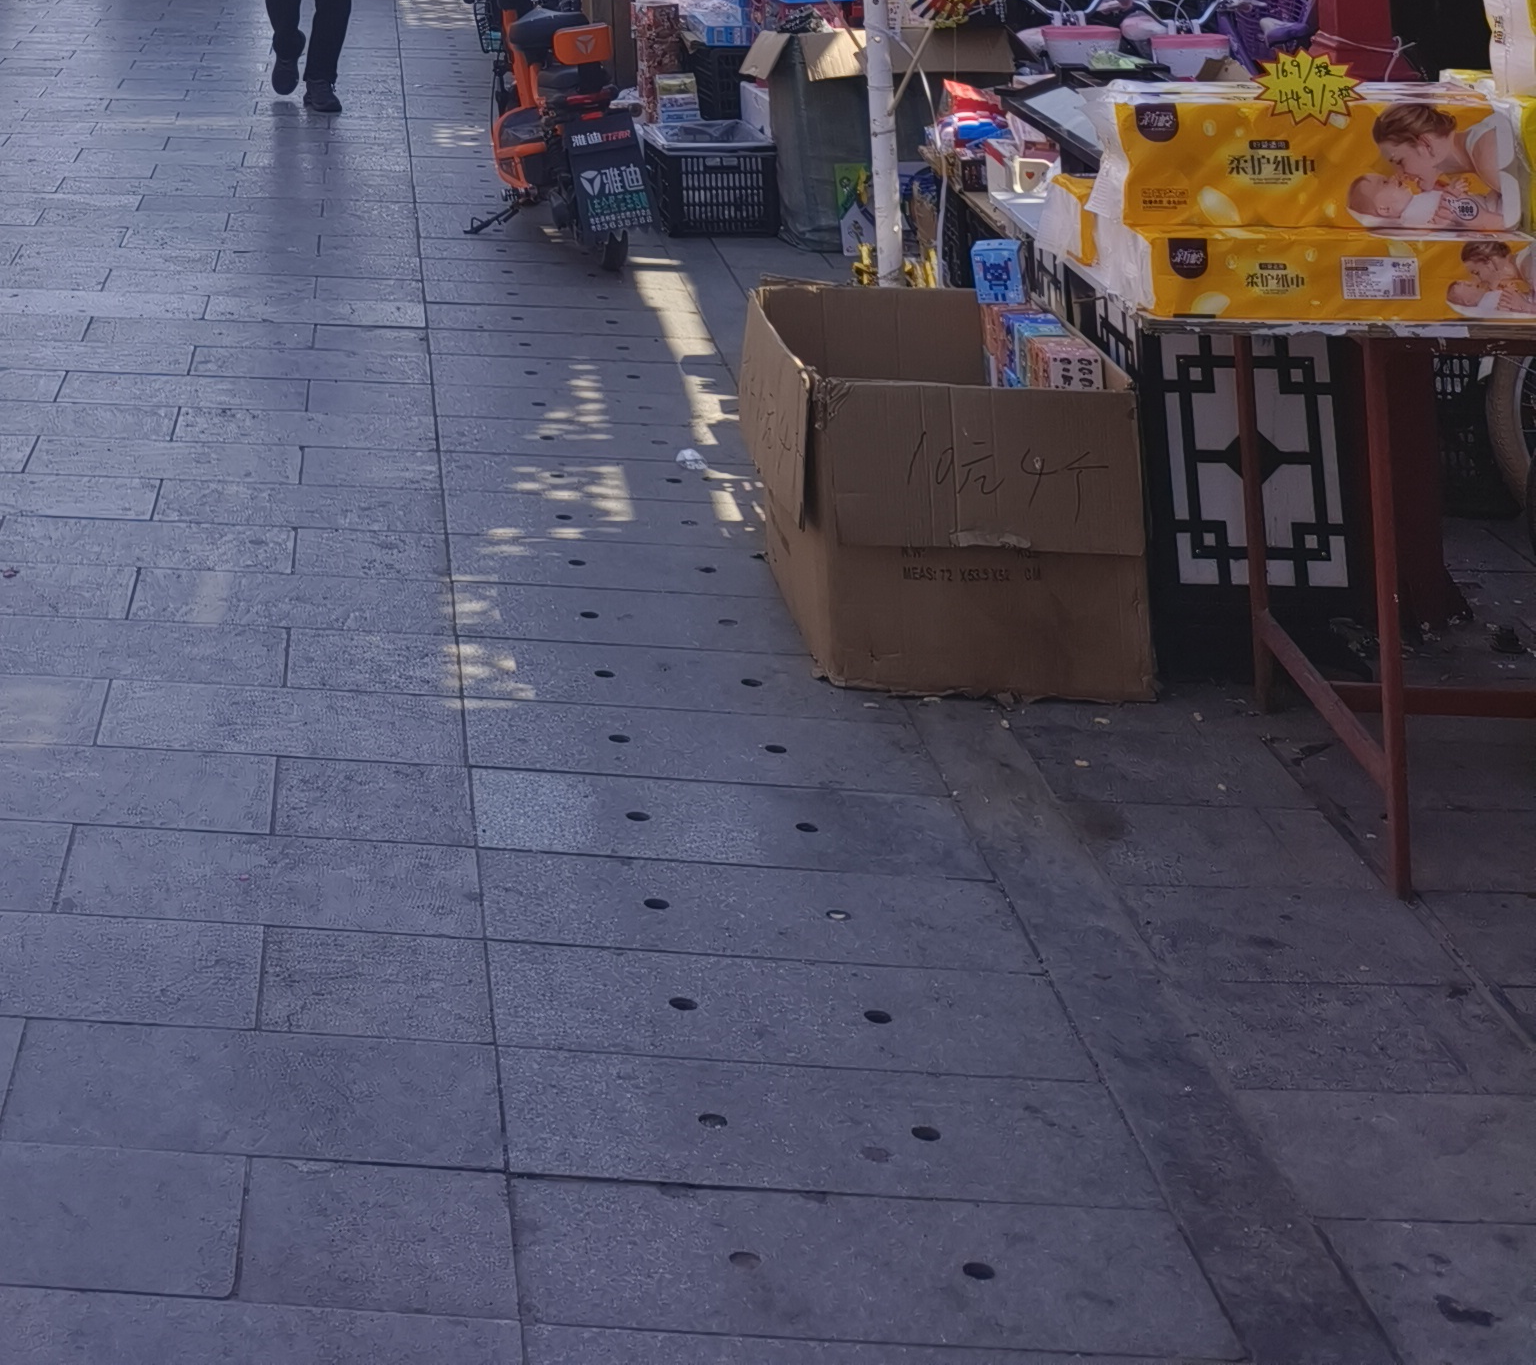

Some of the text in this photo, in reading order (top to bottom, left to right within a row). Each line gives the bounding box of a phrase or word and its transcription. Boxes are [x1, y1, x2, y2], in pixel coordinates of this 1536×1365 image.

[1228, 154, 1317, 176] 柔护纸巾
[600, 163, 645, 195] 雅迪
[1245, 272, 1306, 289] 柔护纸巾
